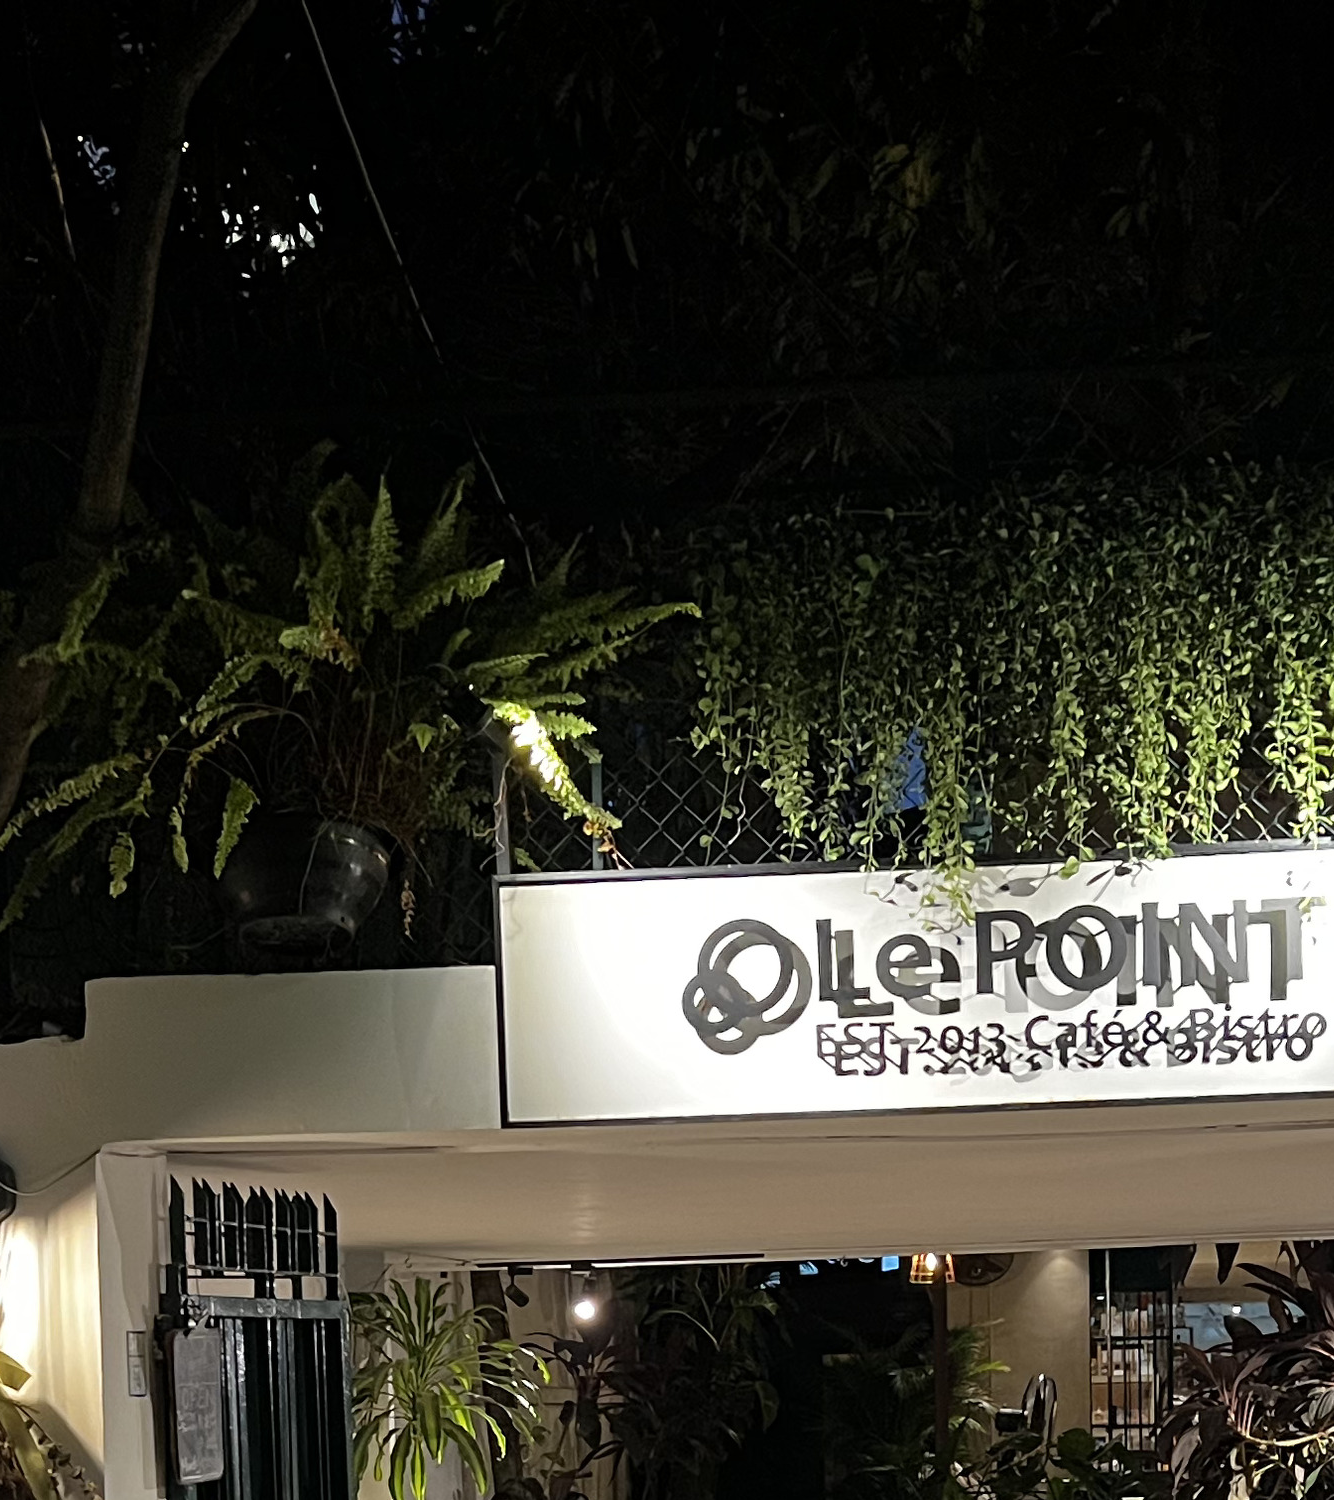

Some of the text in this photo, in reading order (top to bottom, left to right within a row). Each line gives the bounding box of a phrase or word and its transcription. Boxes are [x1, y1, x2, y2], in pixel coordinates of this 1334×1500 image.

[815, 896, 1325, 1002] Le POINT
[1189, 1003, 1328, 1044] Bistro
